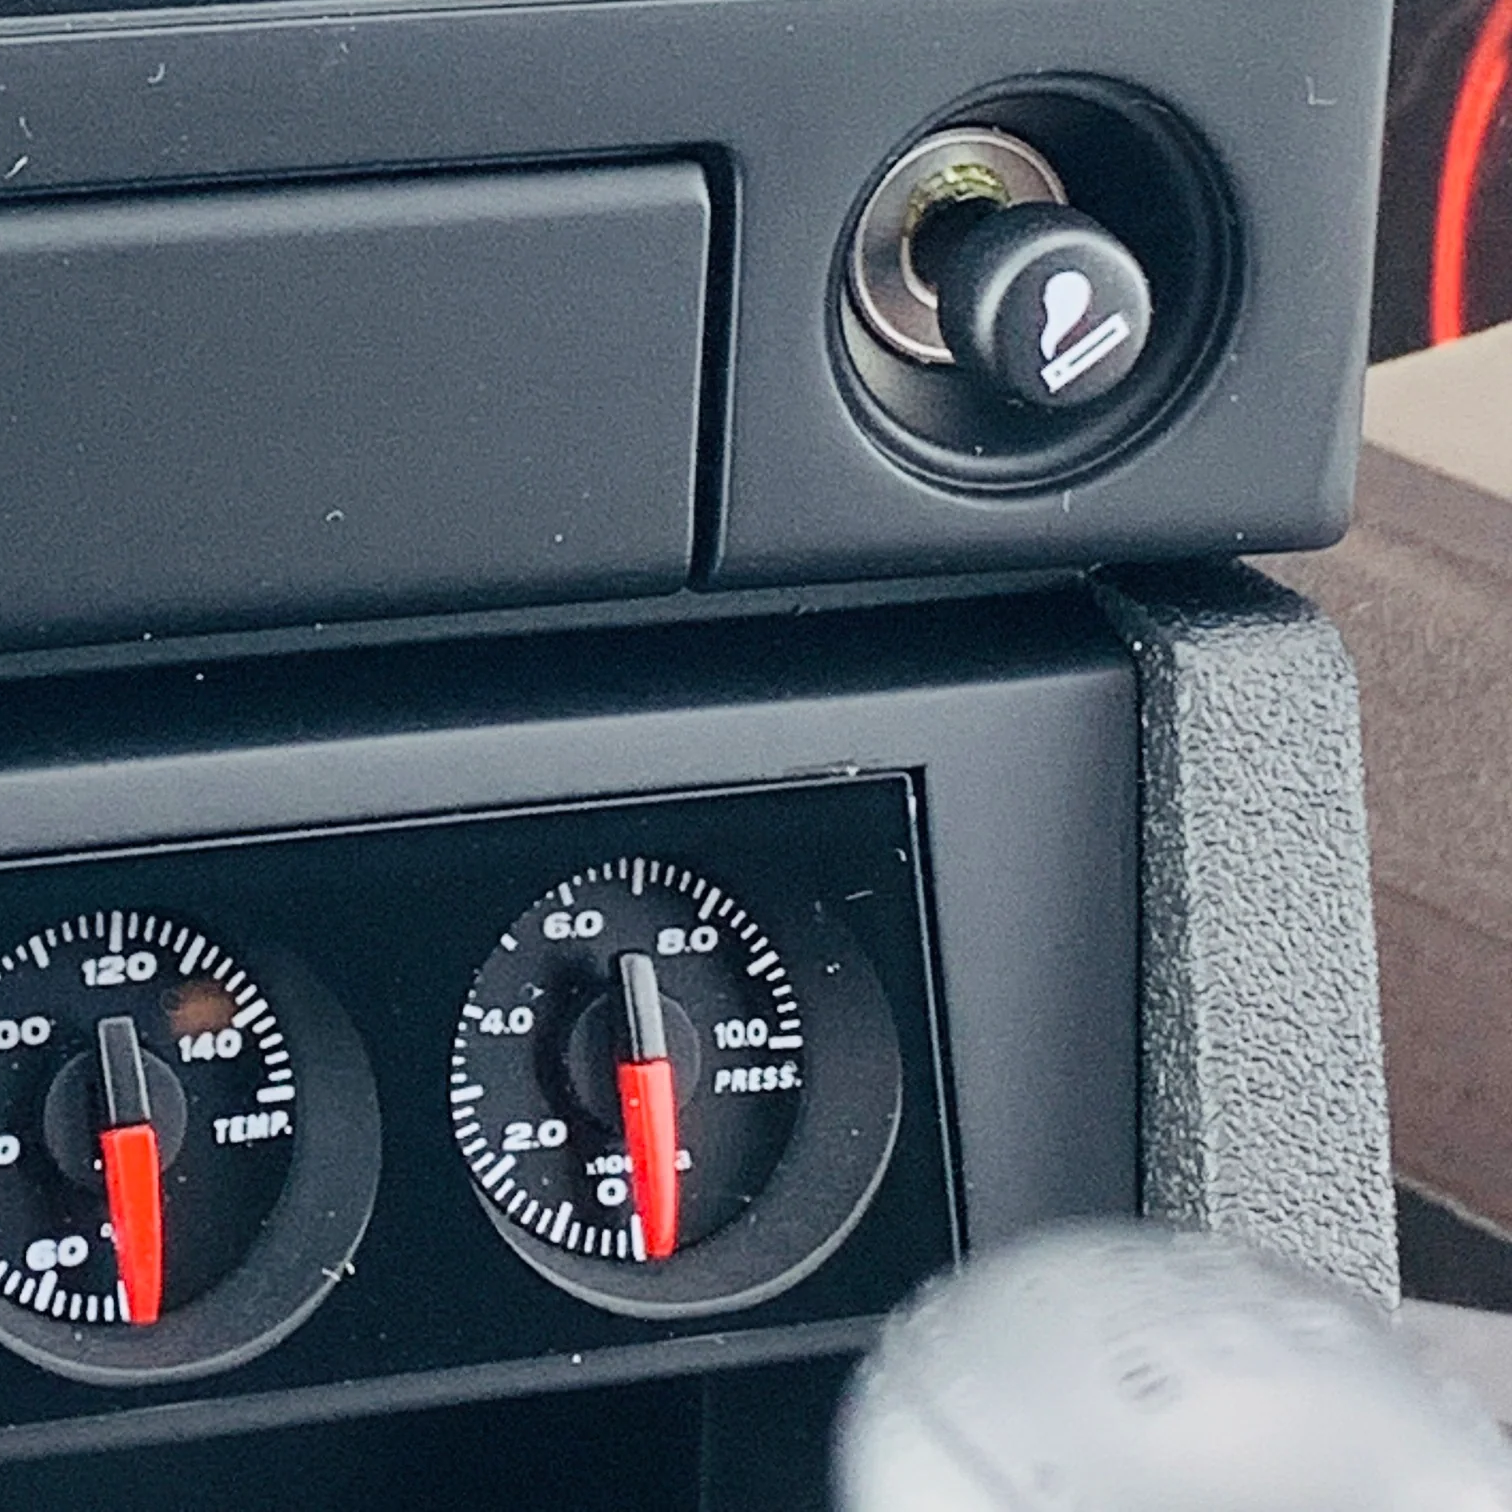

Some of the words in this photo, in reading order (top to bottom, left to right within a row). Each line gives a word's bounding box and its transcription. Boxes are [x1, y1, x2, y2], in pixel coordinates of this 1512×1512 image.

[543, 909, 605, 941] 6.0
[656, 924, 719, 956] 8.0
[81, 951, 159, 987] 120
[480, 1006, 534, 1035] 4.0
[713, 1018, 769, 1050] 10.0
[178, 1029, 244, 1063] 140
[715, 1064, 802, 1093] PRESS.
[501, 1118, 568, 1152] 2.0
[596, 1177, 628, 1207] 0
